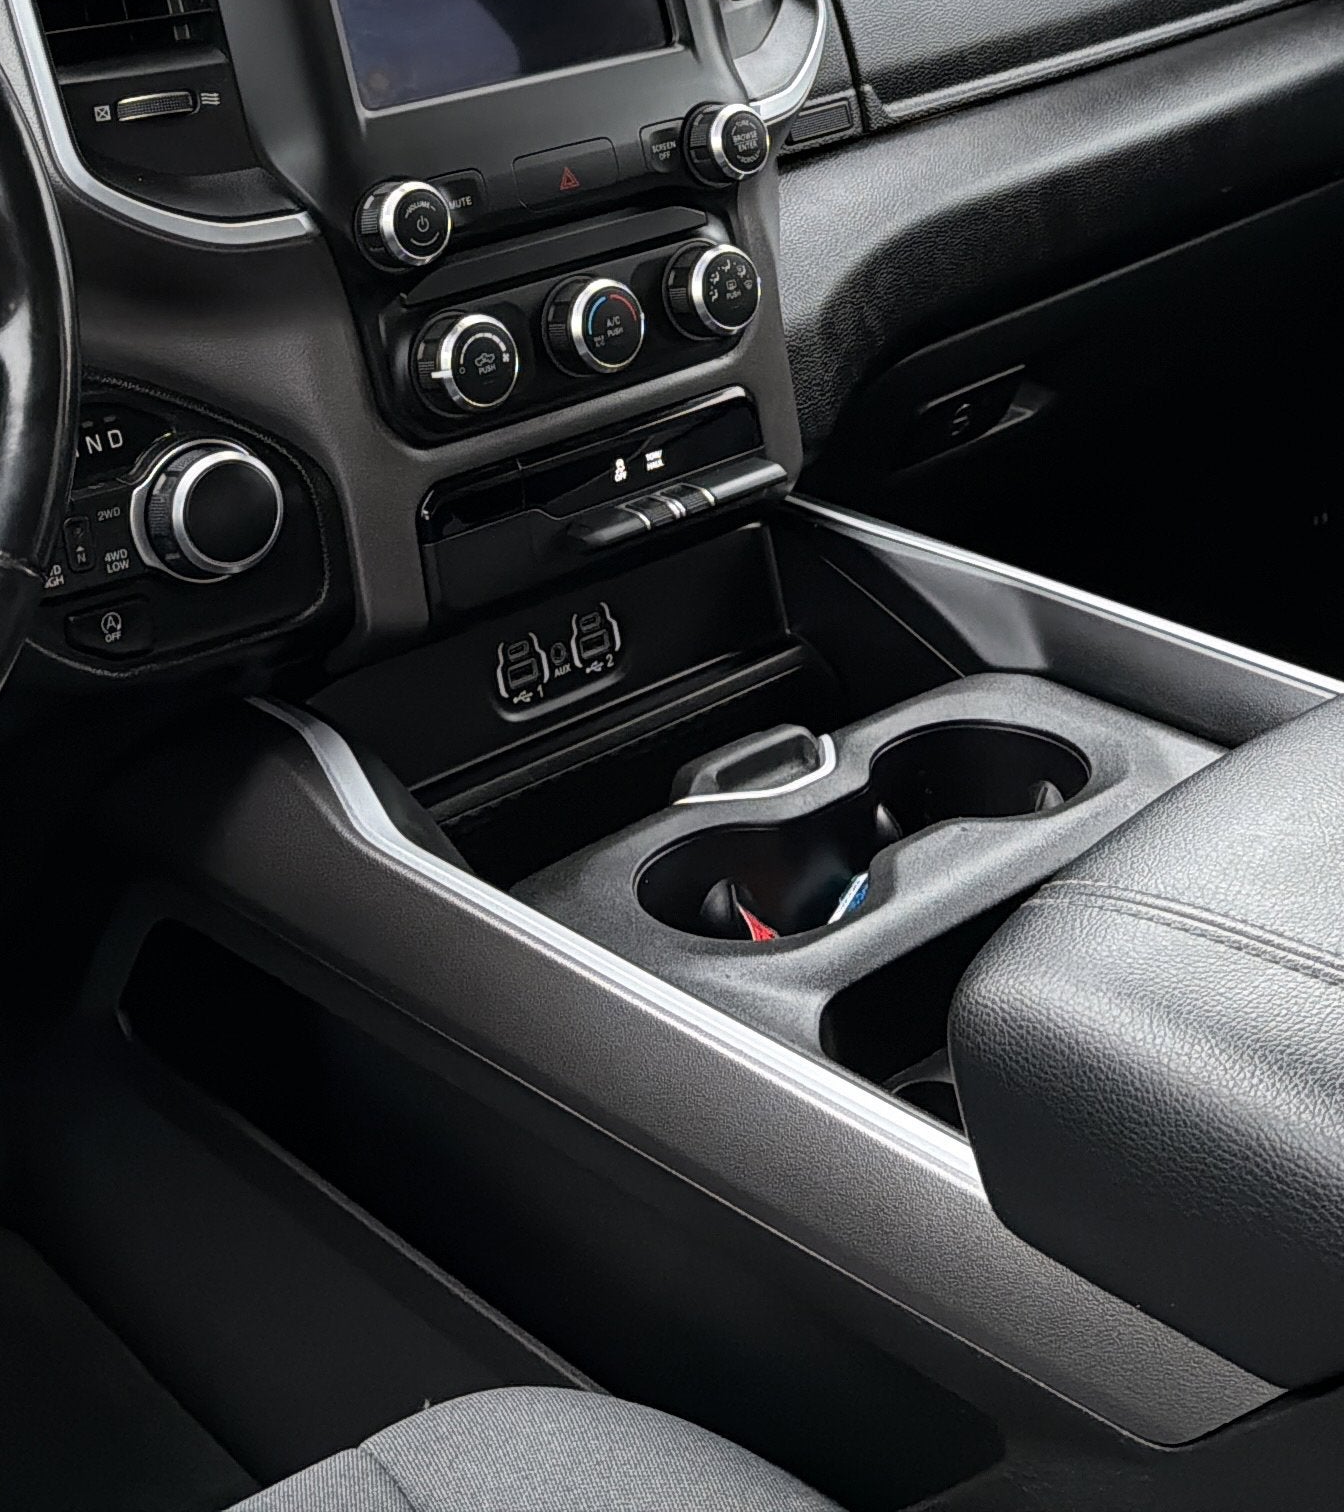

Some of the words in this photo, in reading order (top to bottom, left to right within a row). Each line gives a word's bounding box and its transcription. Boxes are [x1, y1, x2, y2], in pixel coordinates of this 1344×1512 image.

[448, 196, 472, 209] MUTE
[726, 289, 742, 300] PUSH
[606, 315, 621, 328] A/C
[607, 327, 624, 338] PUSH
[478, 363, 496, 375] PUSH
[85, 434, 103, 454] N
[107, 429, 123, 449] D
[97, 507, 120, 522] 2WD
[77, 553, 86, 563] N
[105, 549, 128, 563] 4WD
[107, 559, 129, 573] LOW
[105, 631, 122, 643] OFF
[606, 653, 614, 667] 2
[554, 663, 571, 678] AUX
[537, 684, 544, 698] 1
